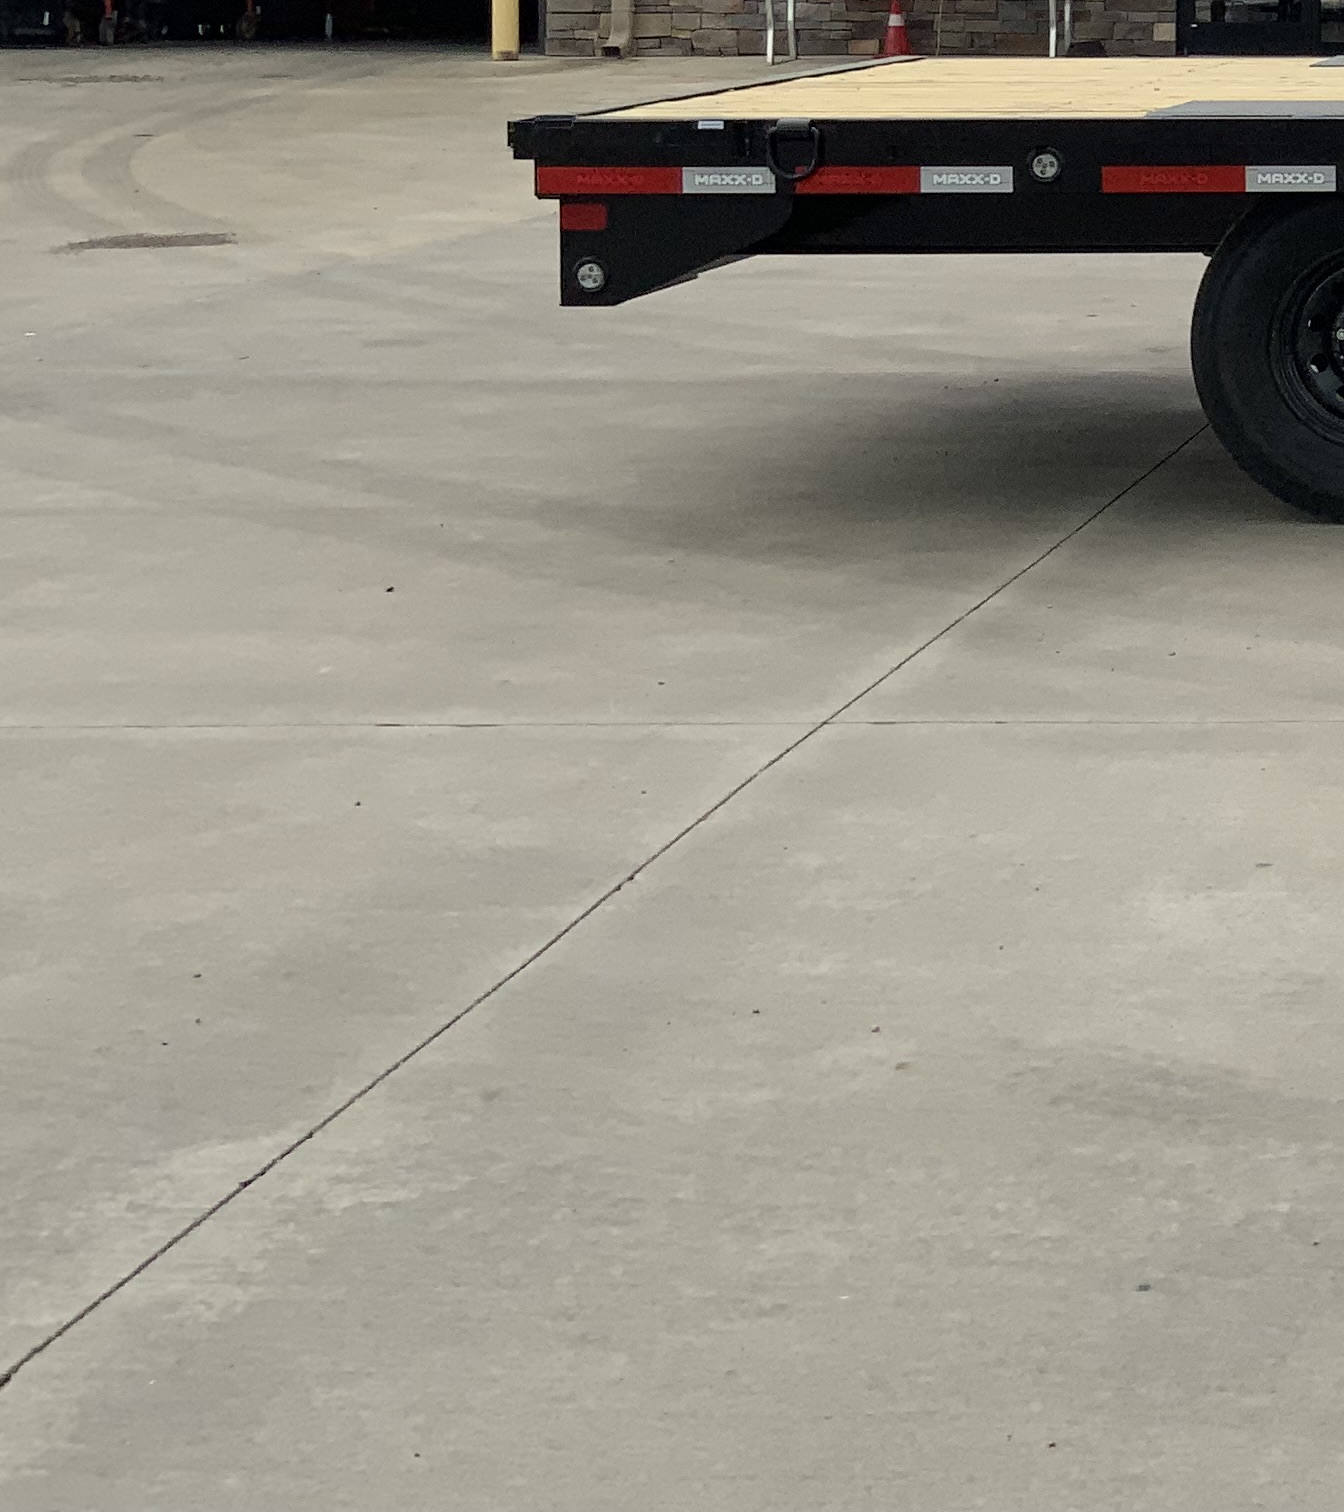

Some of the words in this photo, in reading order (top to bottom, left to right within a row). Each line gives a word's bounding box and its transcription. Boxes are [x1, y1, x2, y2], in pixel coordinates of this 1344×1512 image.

[695, 174, 763, 185] MAXX-D
[933, 173, 1001, 185] MAXX-D
[1257, 173, 1325, 184] MAXX-D
